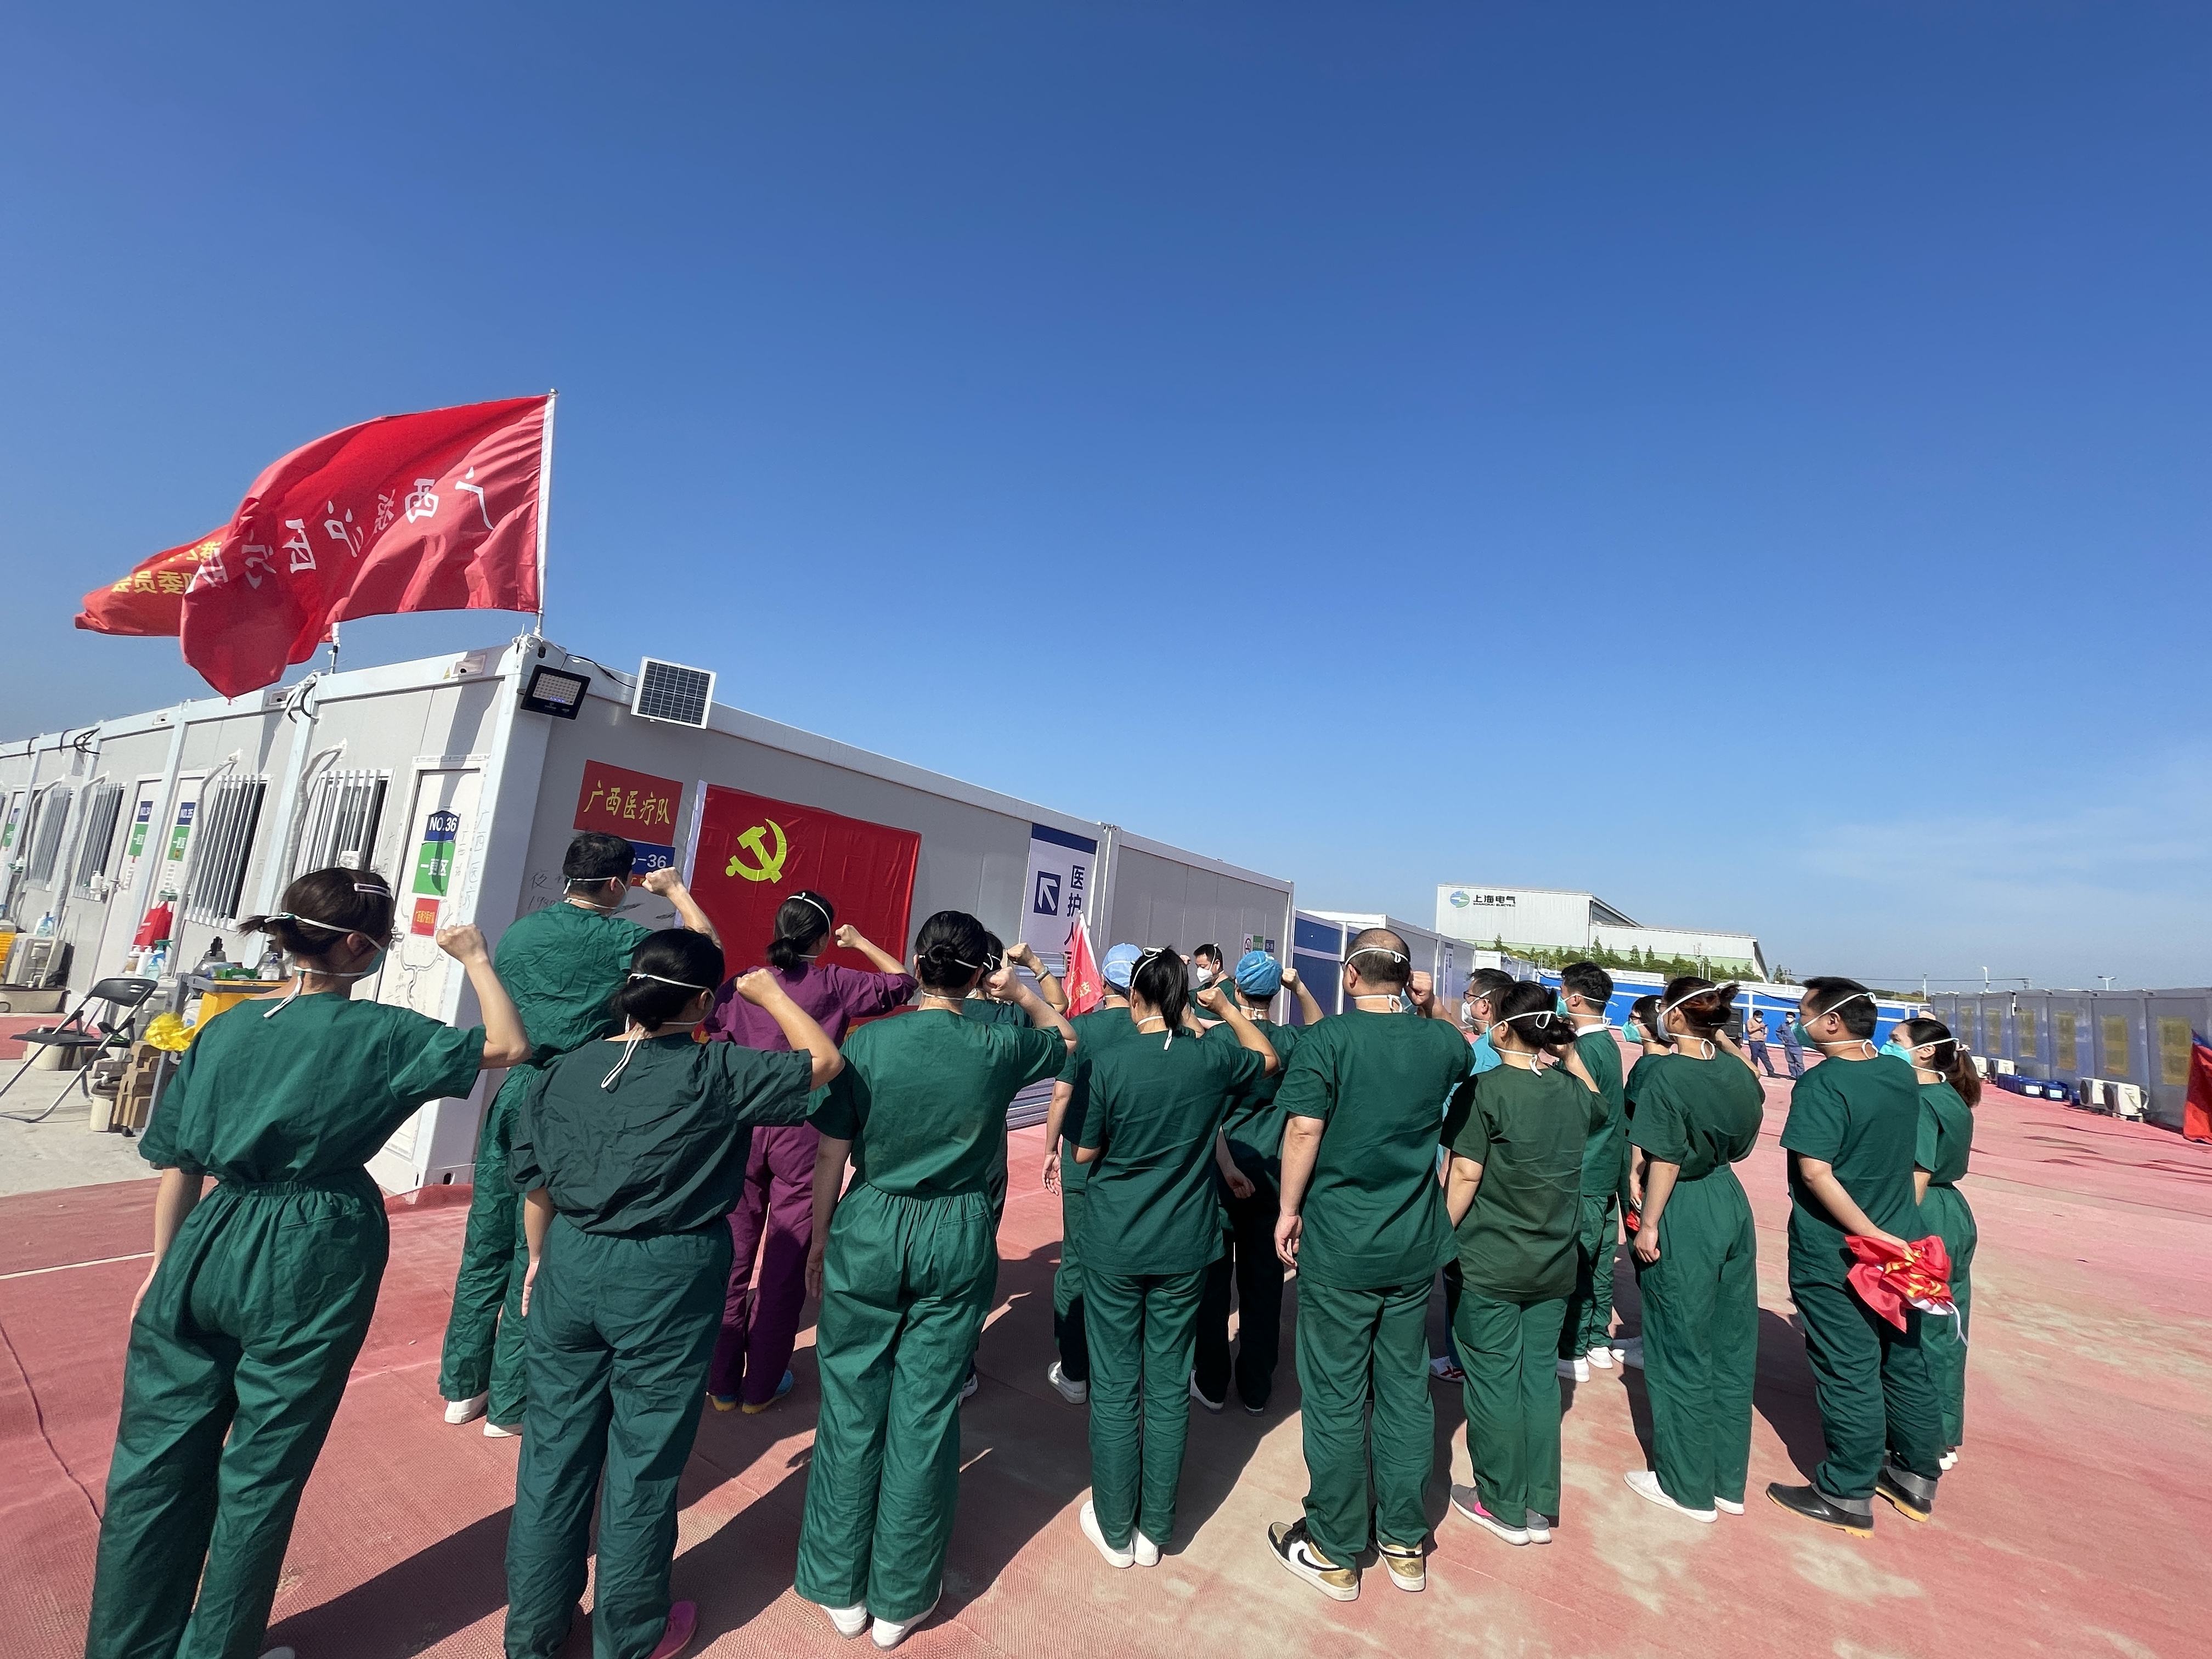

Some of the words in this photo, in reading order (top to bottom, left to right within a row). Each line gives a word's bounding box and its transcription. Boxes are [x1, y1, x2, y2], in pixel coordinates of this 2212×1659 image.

[583, 780, 670, 826] 广西医疗队
[429, 816, 458, 832] NO.36
[631, 854, 667, 868] -36
[1473, 894, 1516, 904] 上海电气
